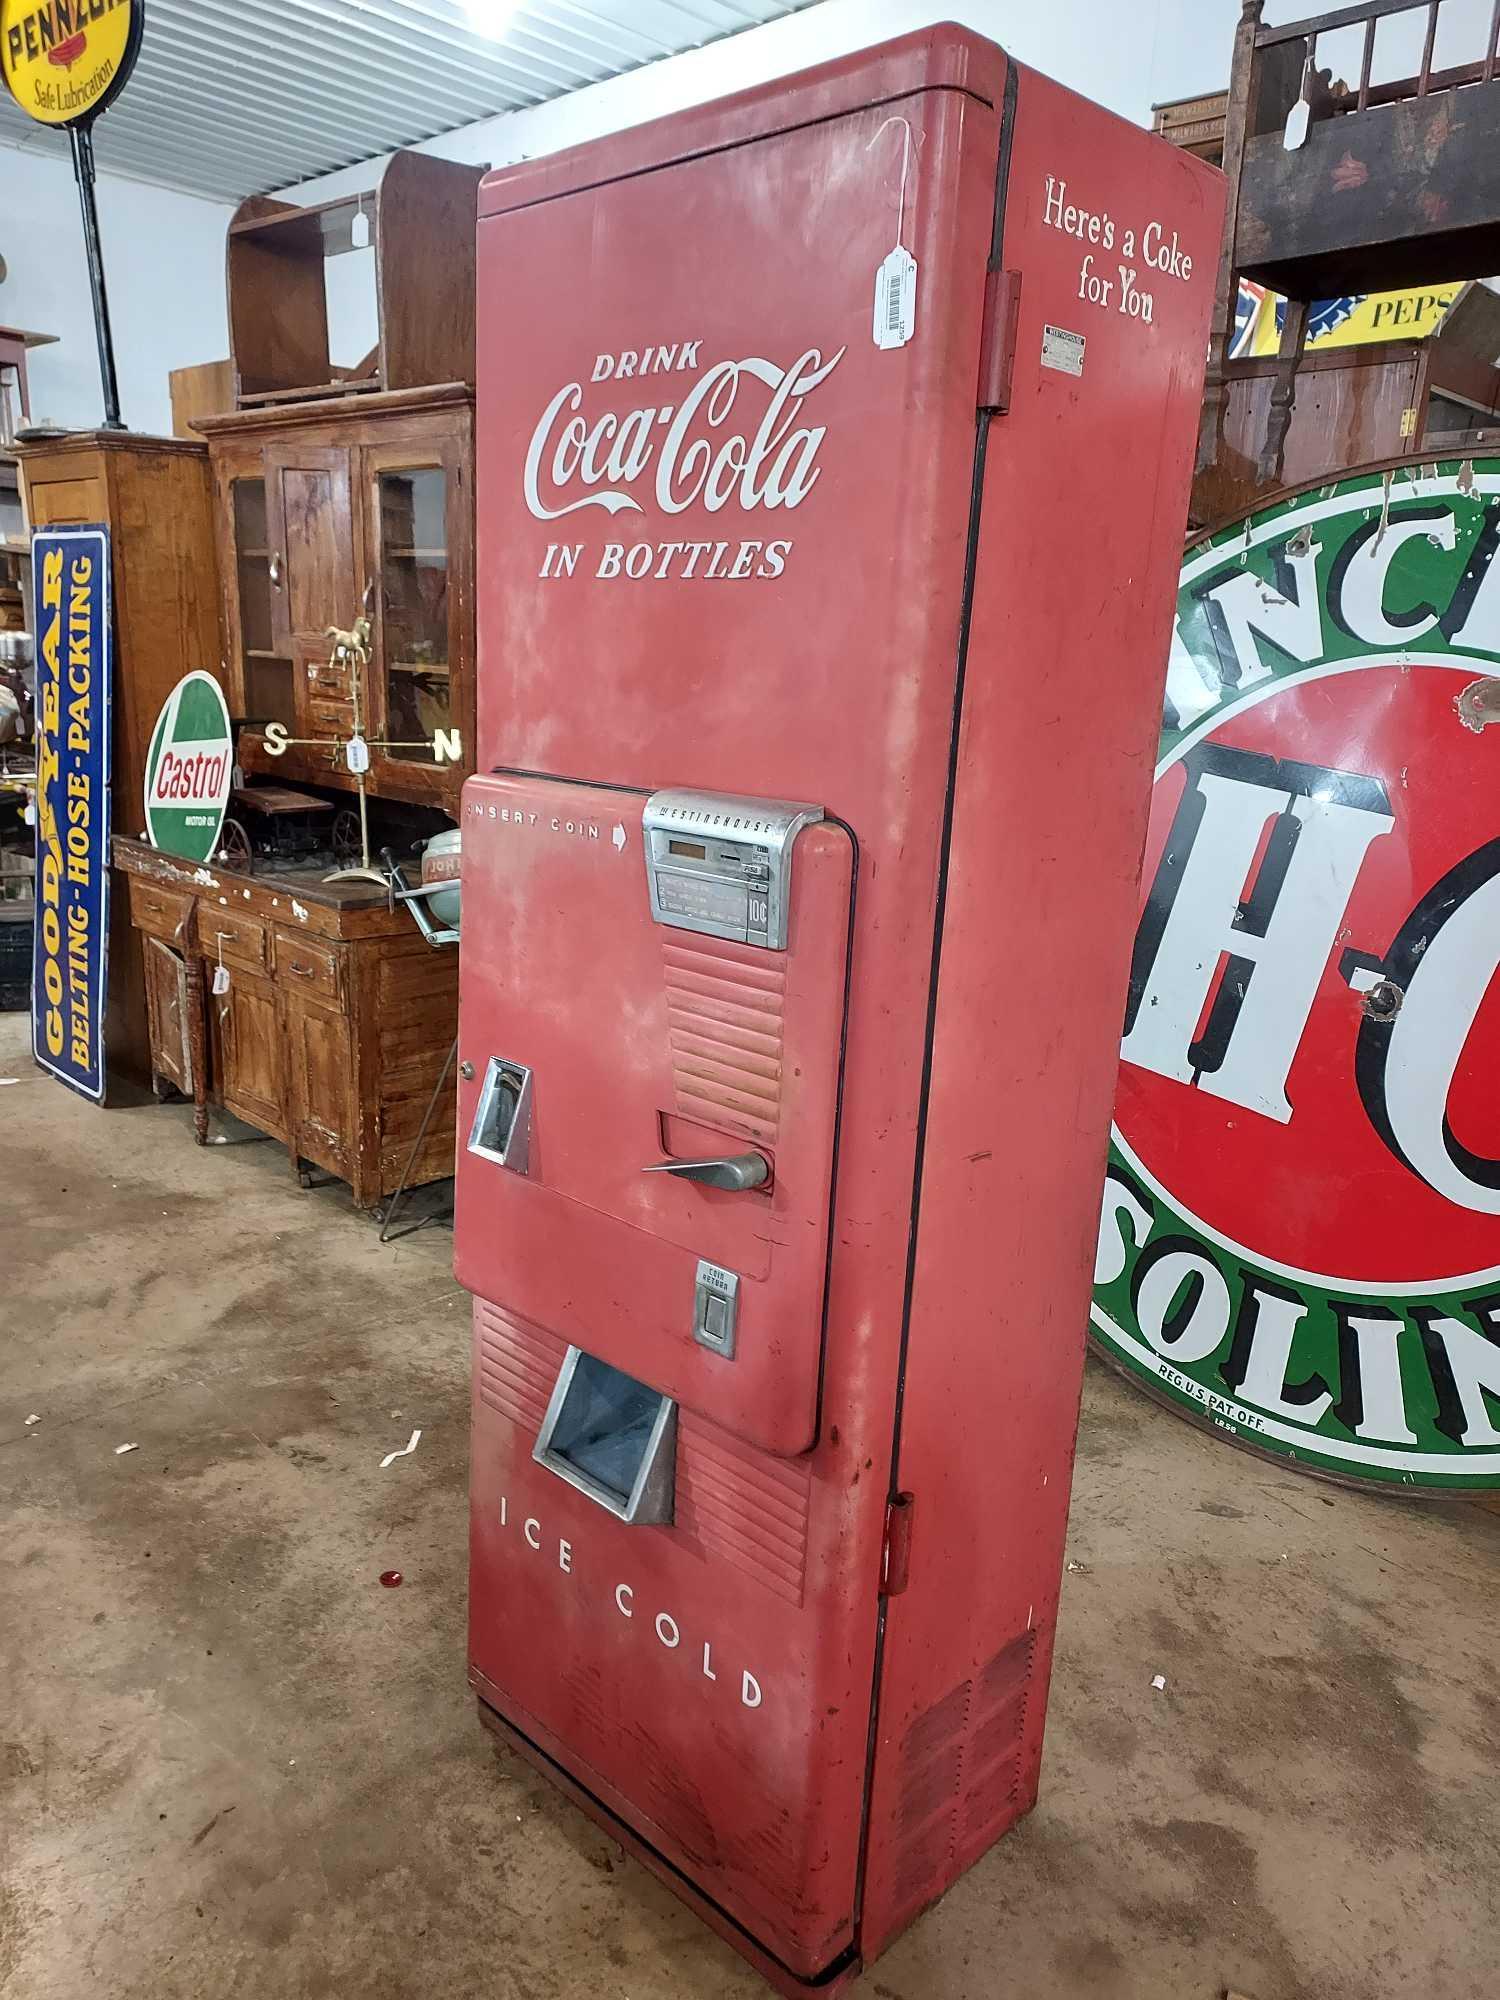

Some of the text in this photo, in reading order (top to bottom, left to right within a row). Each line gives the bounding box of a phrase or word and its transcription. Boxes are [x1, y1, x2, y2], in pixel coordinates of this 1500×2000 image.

[34, 59, 114, 110] Safe Lubrication
[1044, 176, 1192, 281] Here's a Coke
[1078, 255, 1153, 323] for You
[590, 339, 703, 382] DRINK
[523, 344, 847, 520] Coca-Cola
[538, 540, 793, 579] IN BOTTLES
[263, 722, 288, 756] S
[434, 728, 462, 762] N
[157, 749, 228, 799] Castrol
[551, 818, 600, 839] COIN
[659, 806, 773, 833] WESTINGHOUSE
[702, 1273, 729, 1291] RETURN
[709, 1268, 725, 1281] COIN
[1237, 1410, 1265, 1432] OFF.
[500, 1496, 762, 1708] ICE COLD
